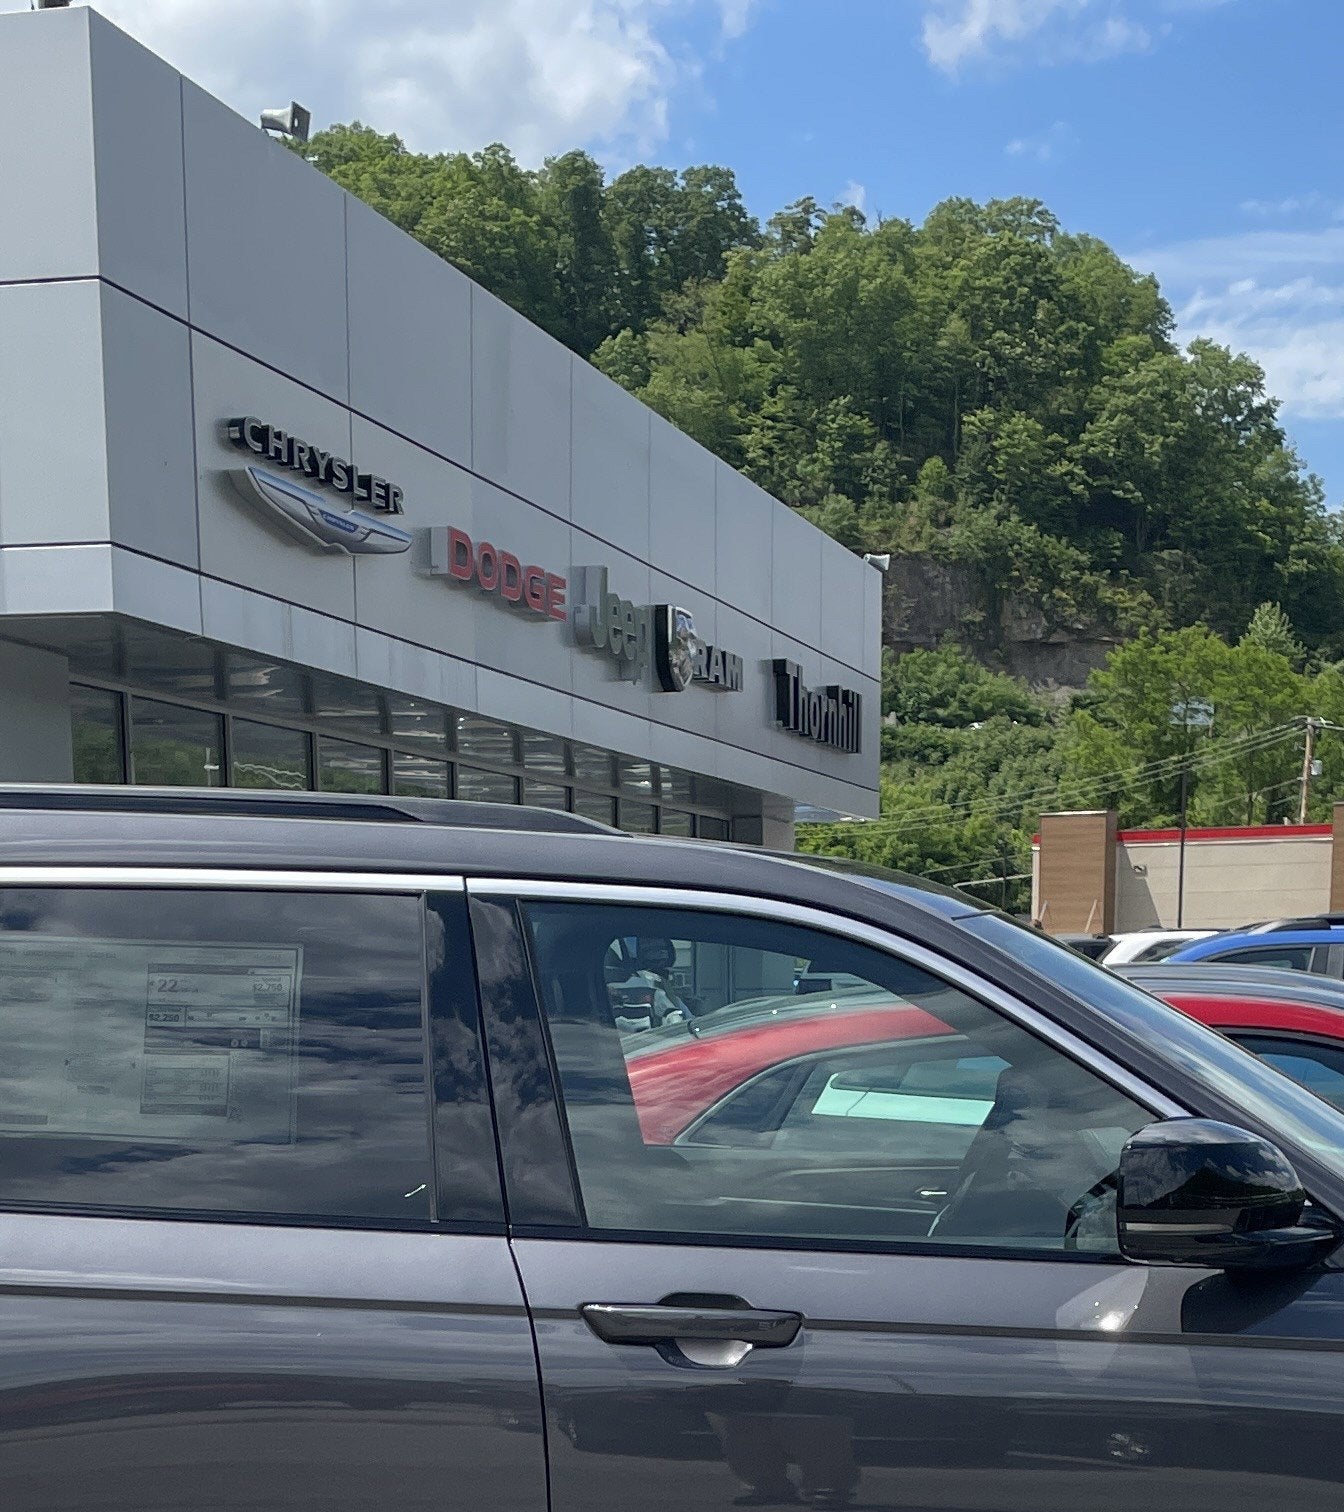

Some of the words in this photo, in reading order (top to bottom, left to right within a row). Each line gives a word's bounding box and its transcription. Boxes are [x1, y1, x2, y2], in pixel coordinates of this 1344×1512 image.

[230, 415, 405, 515] CHRYSLER
[440, 525, 568, 623] DODGE
[574, 565, 655, 687] Jeep
[692, 637, 744, 693] RAM
